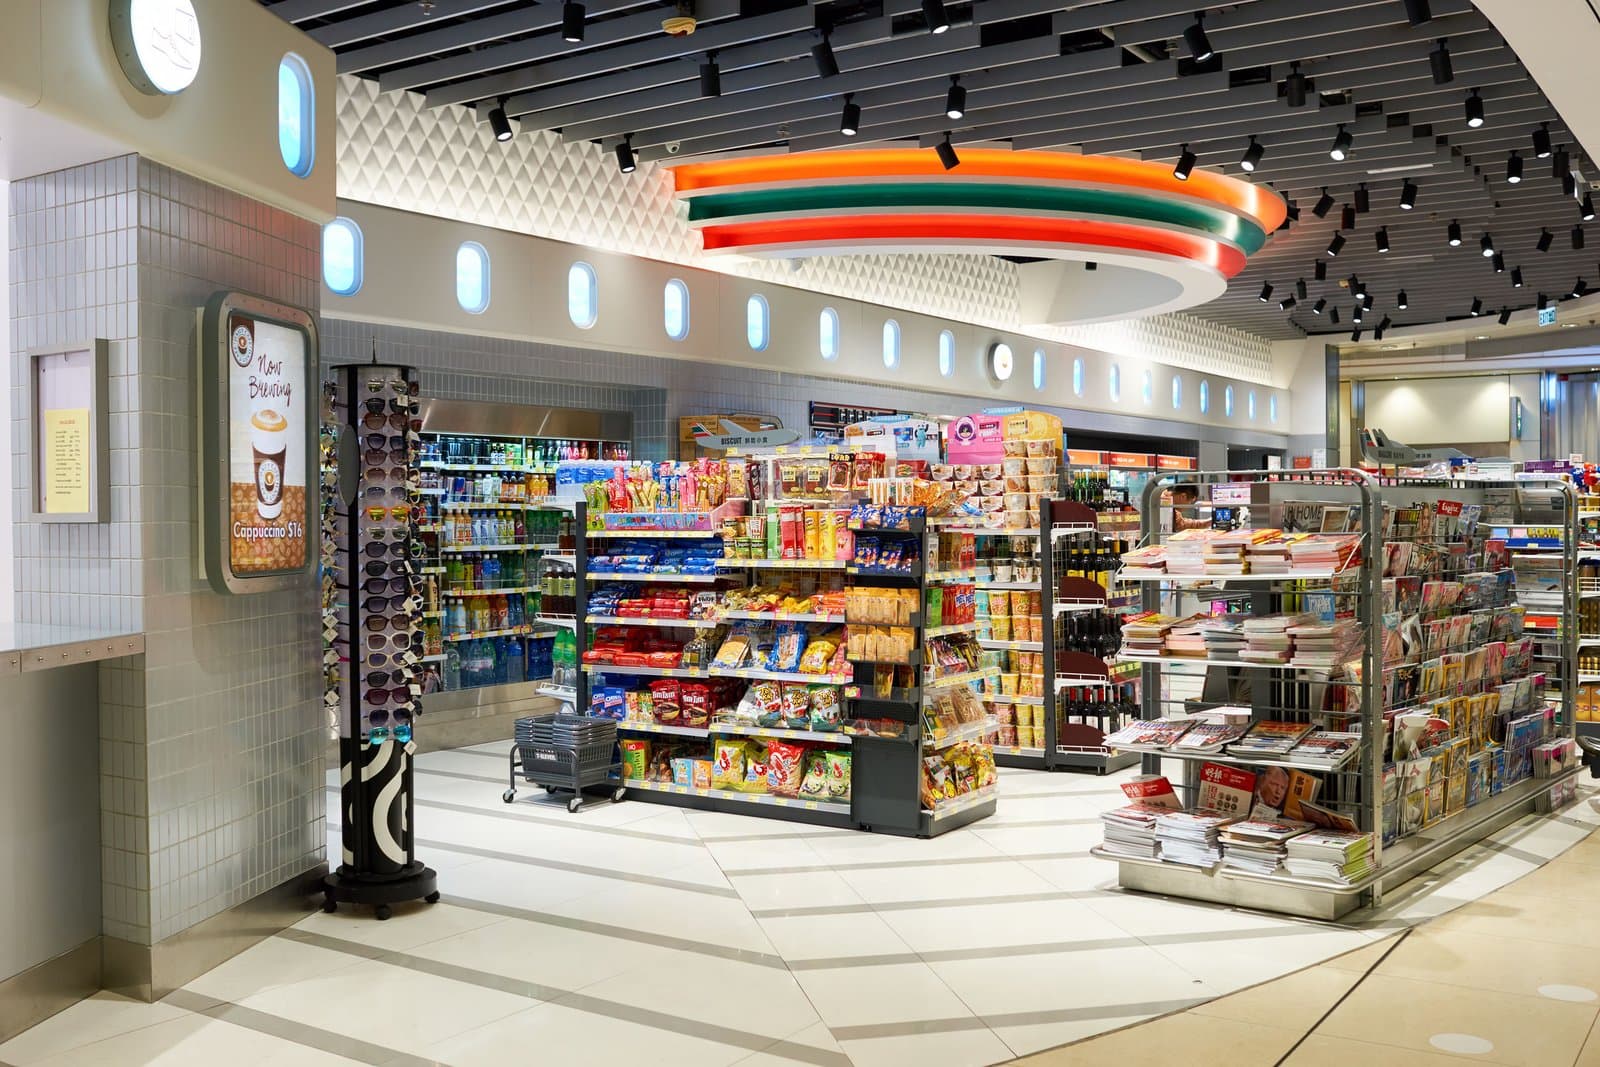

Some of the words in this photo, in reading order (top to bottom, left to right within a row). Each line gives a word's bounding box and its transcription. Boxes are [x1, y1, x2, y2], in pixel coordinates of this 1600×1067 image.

[257, 353, 283, 376] Now
[248, 375, 292, 407] Brewing
[721, 436, 742, 445] BISCUIT
[233, 521, 286, 542] Cappuccino
[287, 521, 303, 539] $16
